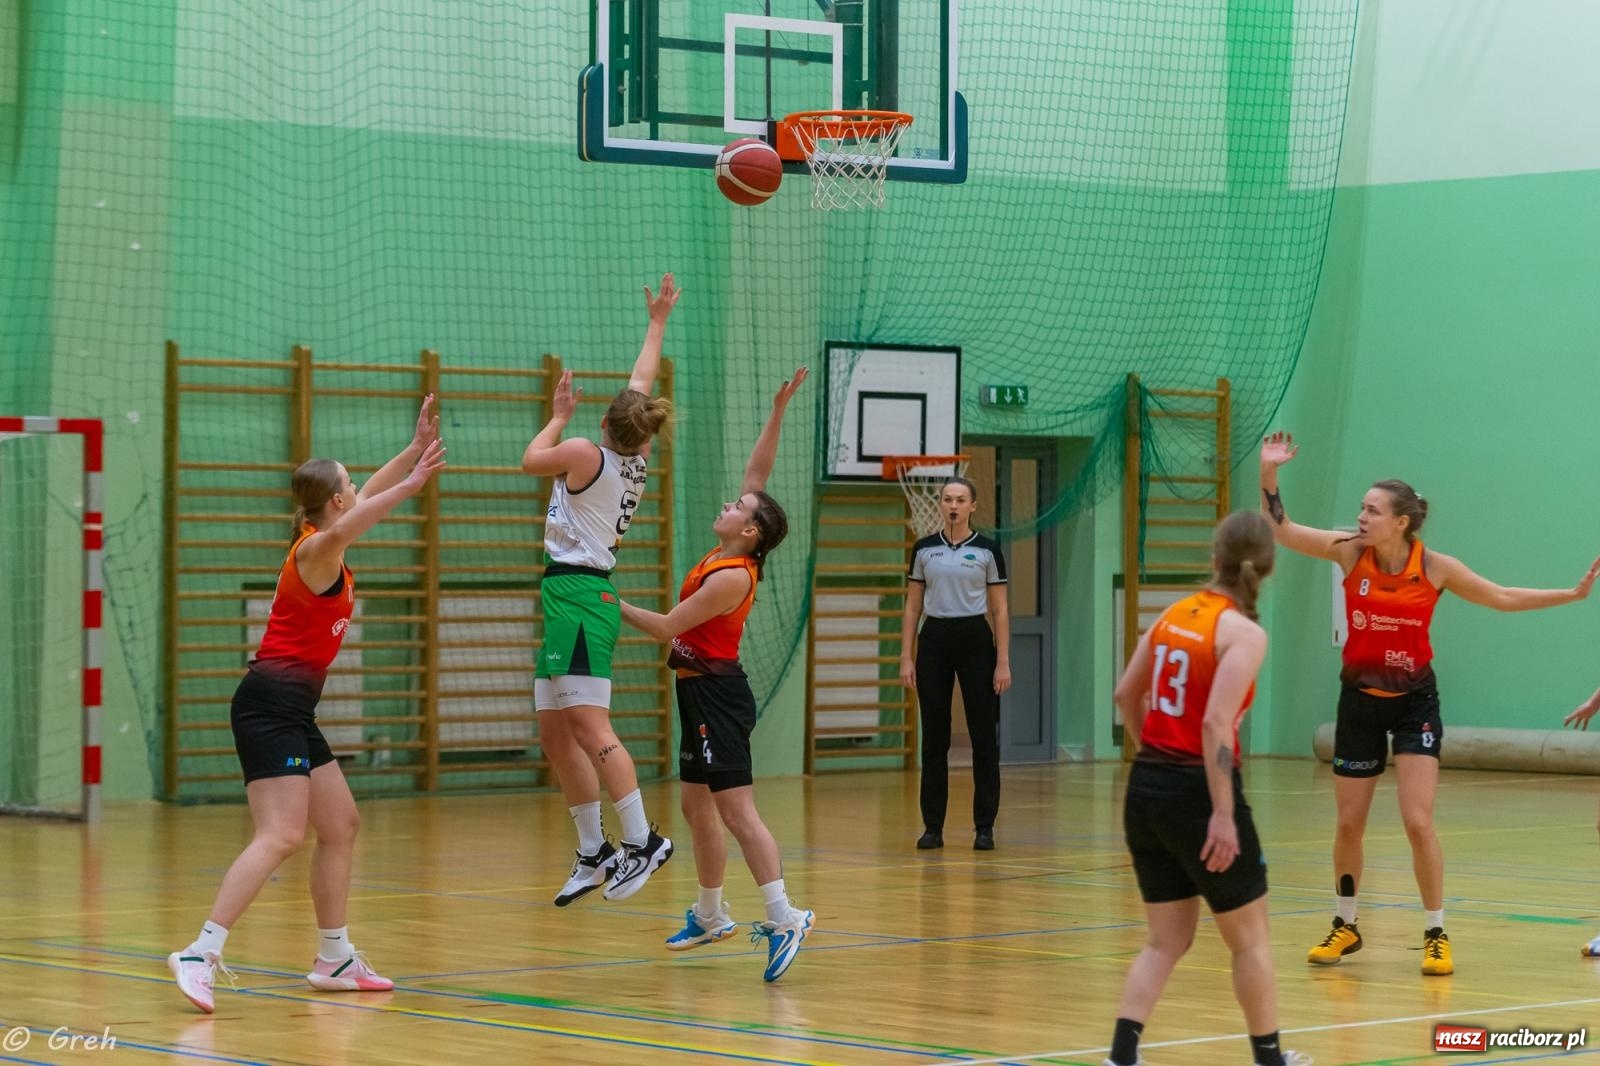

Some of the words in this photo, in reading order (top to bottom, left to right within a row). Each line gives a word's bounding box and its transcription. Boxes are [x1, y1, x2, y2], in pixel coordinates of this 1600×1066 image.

[1359, 578, 1370, 596] 8
[1151, 644, 1190, 718] 13
[703, 740, 713, 764] 4
